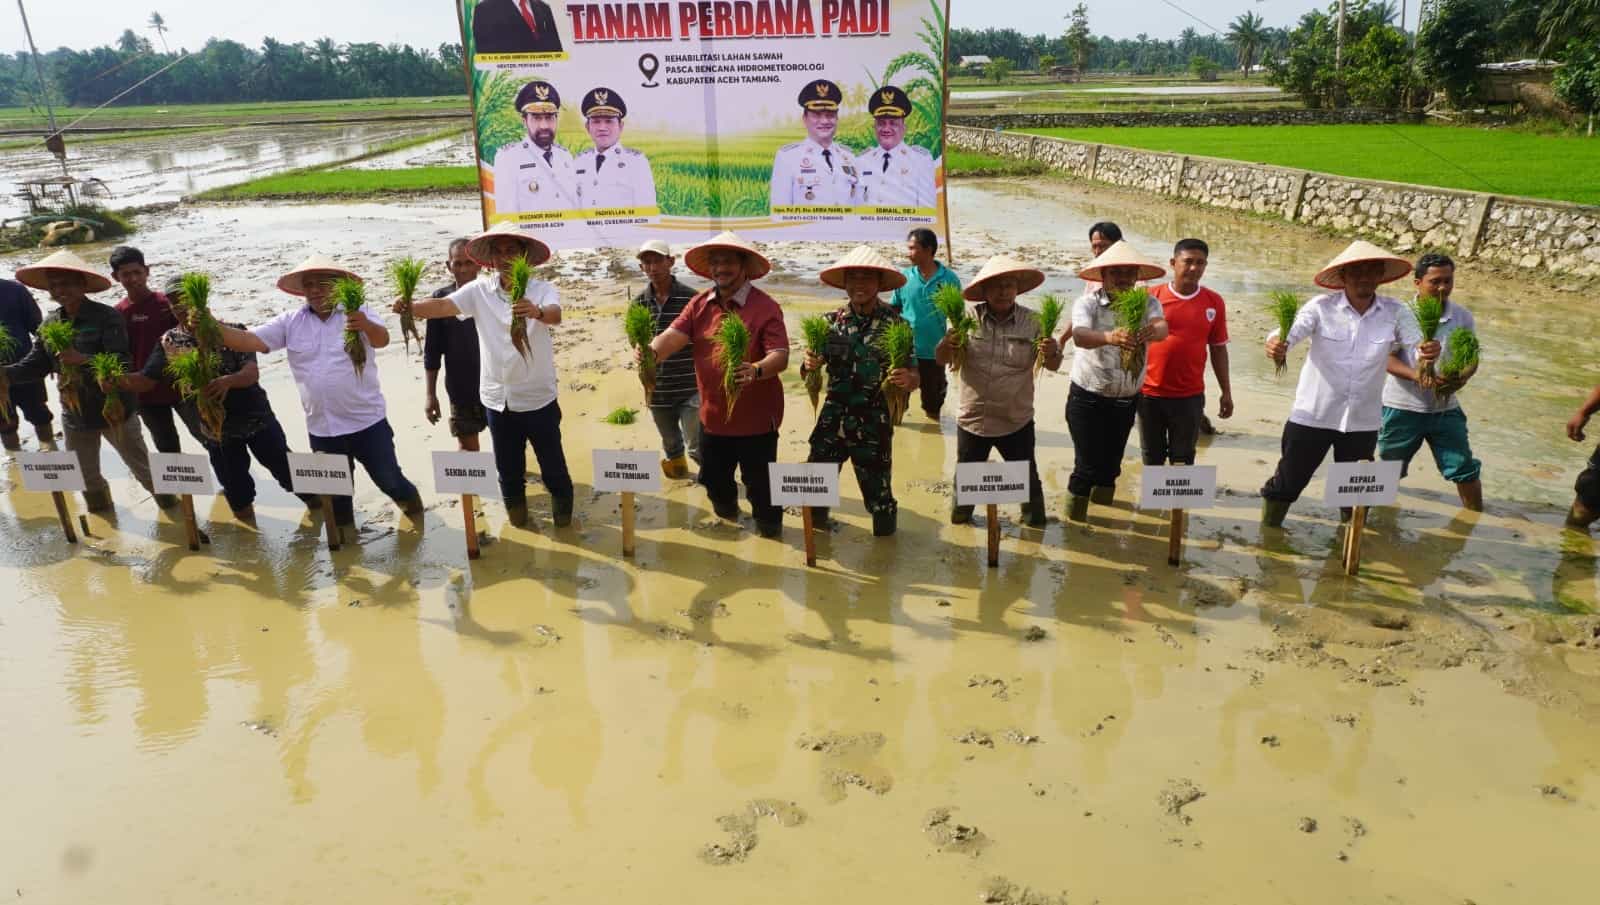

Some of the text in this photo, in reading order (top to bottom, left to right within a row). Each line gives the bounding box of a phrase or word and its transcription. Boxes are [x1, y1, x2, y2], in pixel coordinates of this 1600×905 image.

[566, 0, 892, 43] TANAM PERDANA PADI
[665, 52, 783, 62] REHABILITASI LAHAN SAWAH
[665, 63, 825, 74] PASCA BENCANA HIDROMETEOROLOGI
[666, 75, 781, 85] KABUPATEN ACEH TAMIANG.
[615, 462, 638, 470] BUPATI
[323, 470, 329, 478] 2
[329, 470, 346, 479] ACEH
[444, 468, 486, 477] SEKDA ACEH
[604, 471, 650, 480] ACEH TAMIANG
[1165, 479, 1190, 487] KAJARI
[1349, 475, 1376, 484] KEPALA
[781, 485, 799, 493] ACEH
[979, 484, 996, 492] ACEH
[996, 483, 1025, 491] TAMIANG
[1152, 488, 1204, 496] ACEH TAMIANG
[1366, 484, 1385, 493] ACEH
